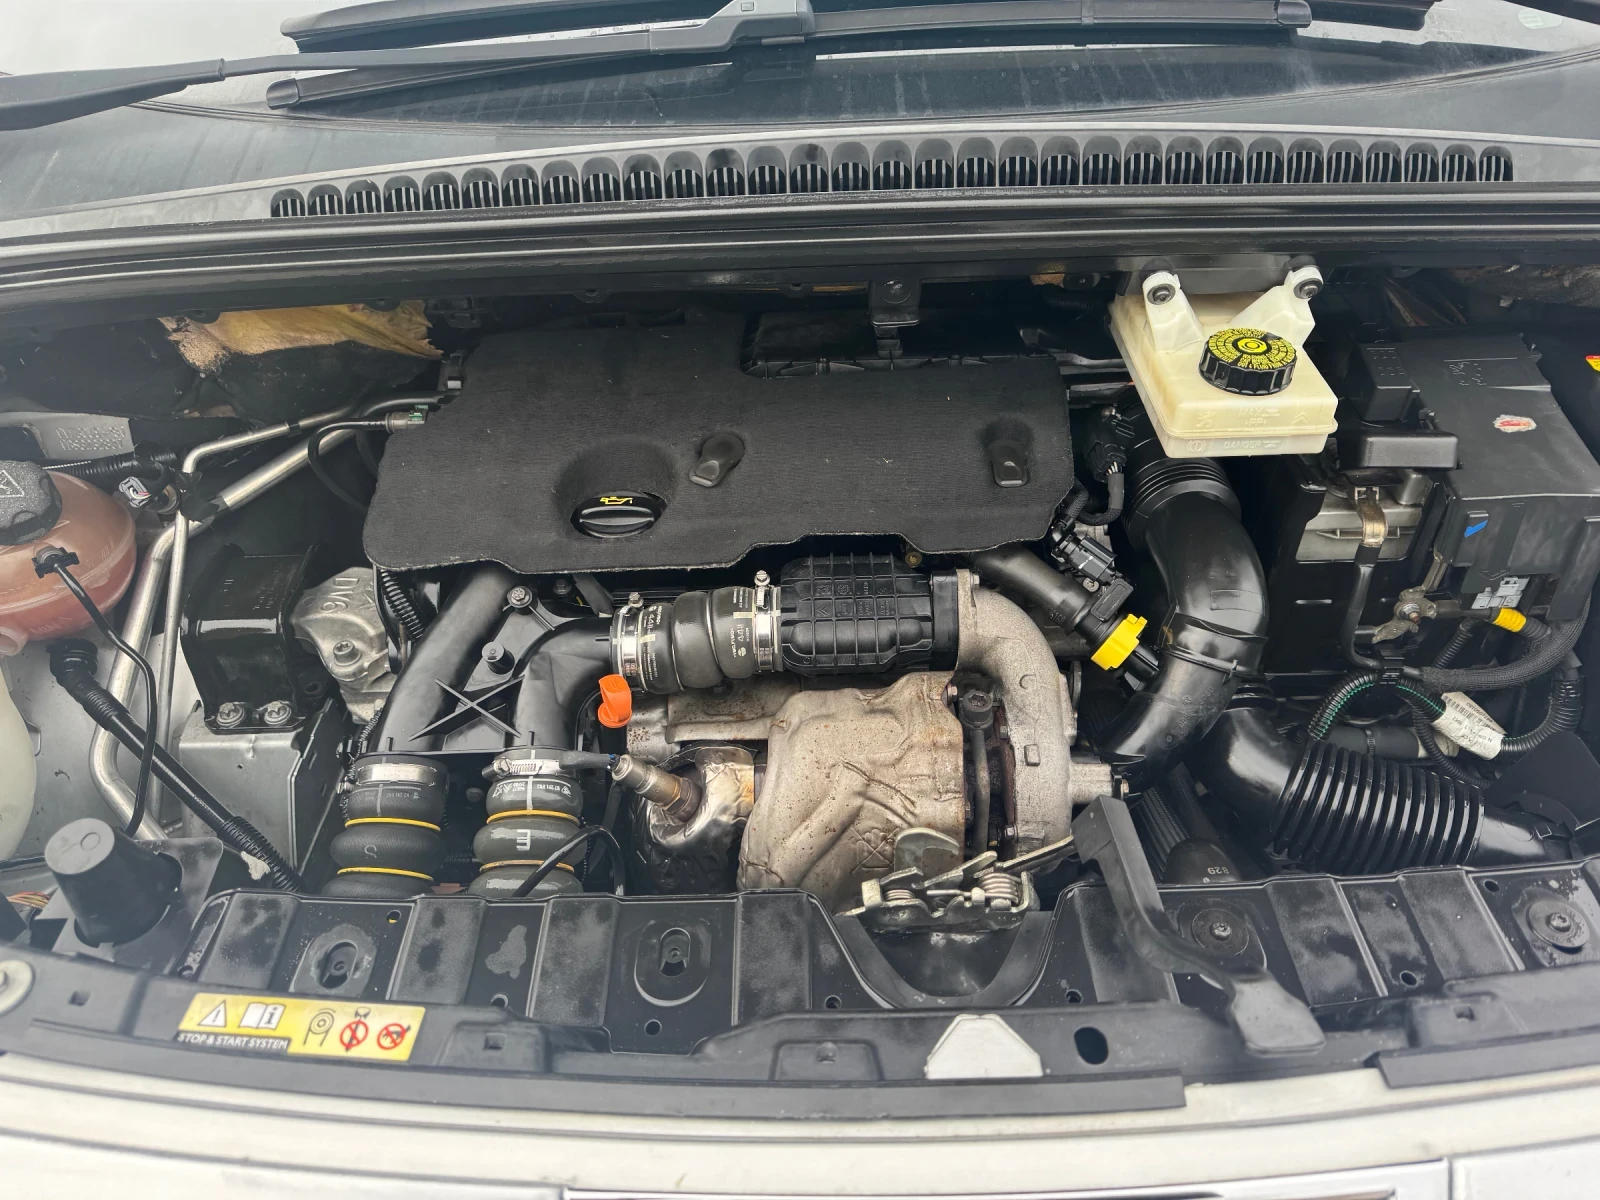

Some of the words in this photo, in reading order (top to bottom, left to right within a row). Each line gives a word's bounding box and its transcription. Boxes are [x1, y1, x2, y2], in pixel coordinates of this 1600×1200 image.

[1222, 440, 1261, 449] DANGER
[320, 576, 360, 613] DV6
[177, 1032, 207, 1043] STOP
[206, 1035, 215, 1045] &
[215, 1035, 248, 1047] START
[248, 1038, 289, 1049] SYSTEM
